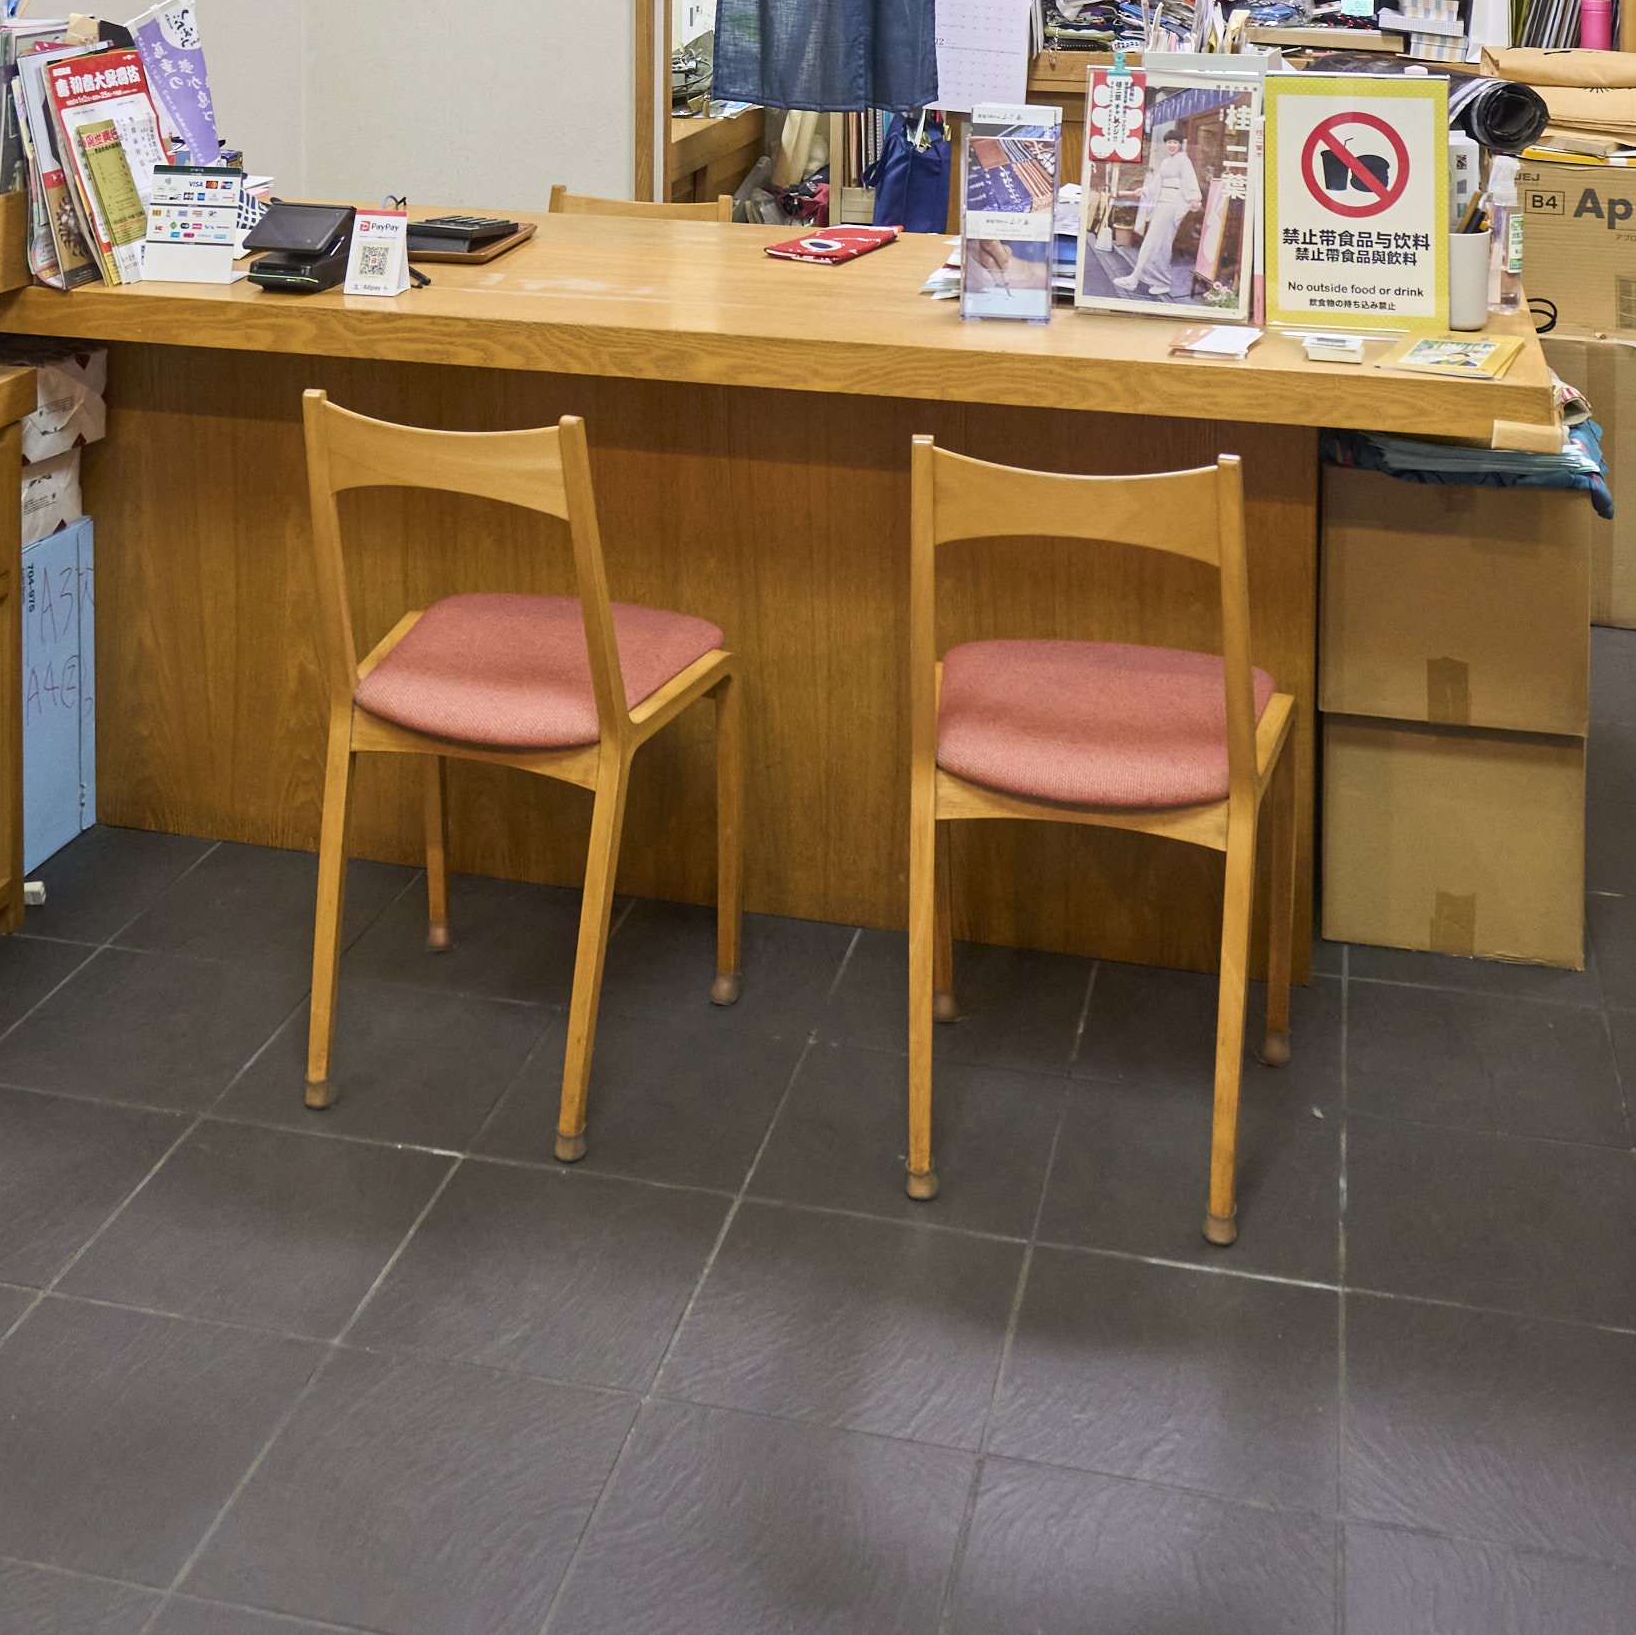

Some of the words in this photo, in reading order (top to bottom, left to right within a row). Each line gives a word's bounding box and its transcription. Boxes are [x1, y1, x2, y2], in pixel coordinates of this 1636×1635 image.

[1222, 104, 1251, 200] 桂二葉
[1532, 195, 1558, 209] B4
[371, 223, 399, 232] PayPay
[1282, 228, 1430, 251] 禁止带食品与饮料
[1295, 247, 1417, 266] 禁止帶食品與飲料
[1288, 281, 1304, 291] No
[1306, 283, 1348, 294] outside
[1351, 285, 1376, 295] food
[1394, 287, 1424, 297] drink
[1309, 298, 1396, 311] 飲食物の持ち込み禁止
